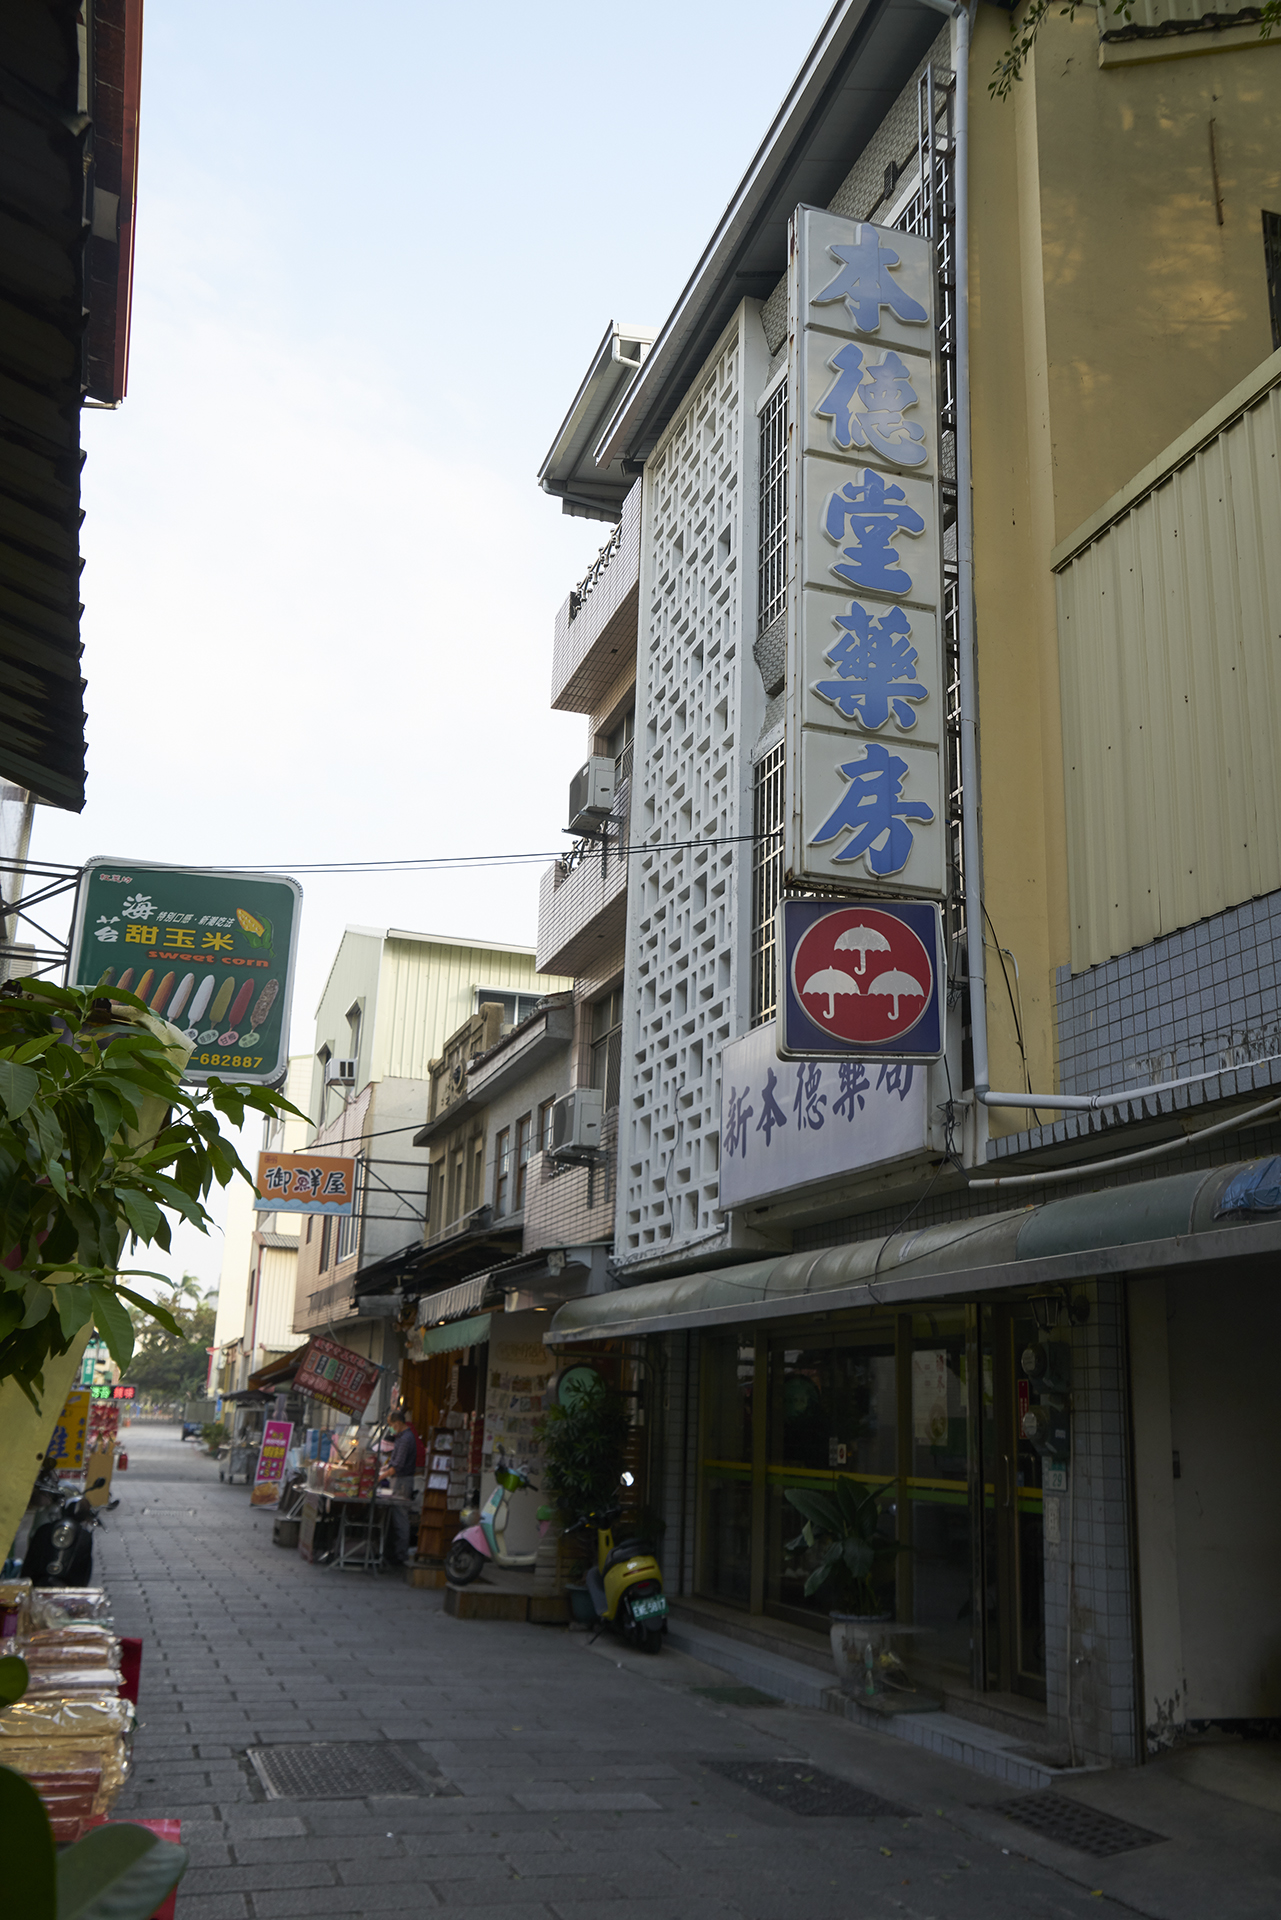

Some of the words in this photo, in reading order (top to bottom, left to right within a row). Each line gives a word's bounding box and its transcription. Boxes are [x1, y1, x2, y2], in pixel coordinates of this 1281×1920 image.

[809, 223, 936, 877] 本德堂藥房
[125, 924, 234, 951] 甜玉米
[148, 951, 215, 963] sweet
[221, 957, 269, 968] corn
[1052, 1473, 1063, 1487] 29
